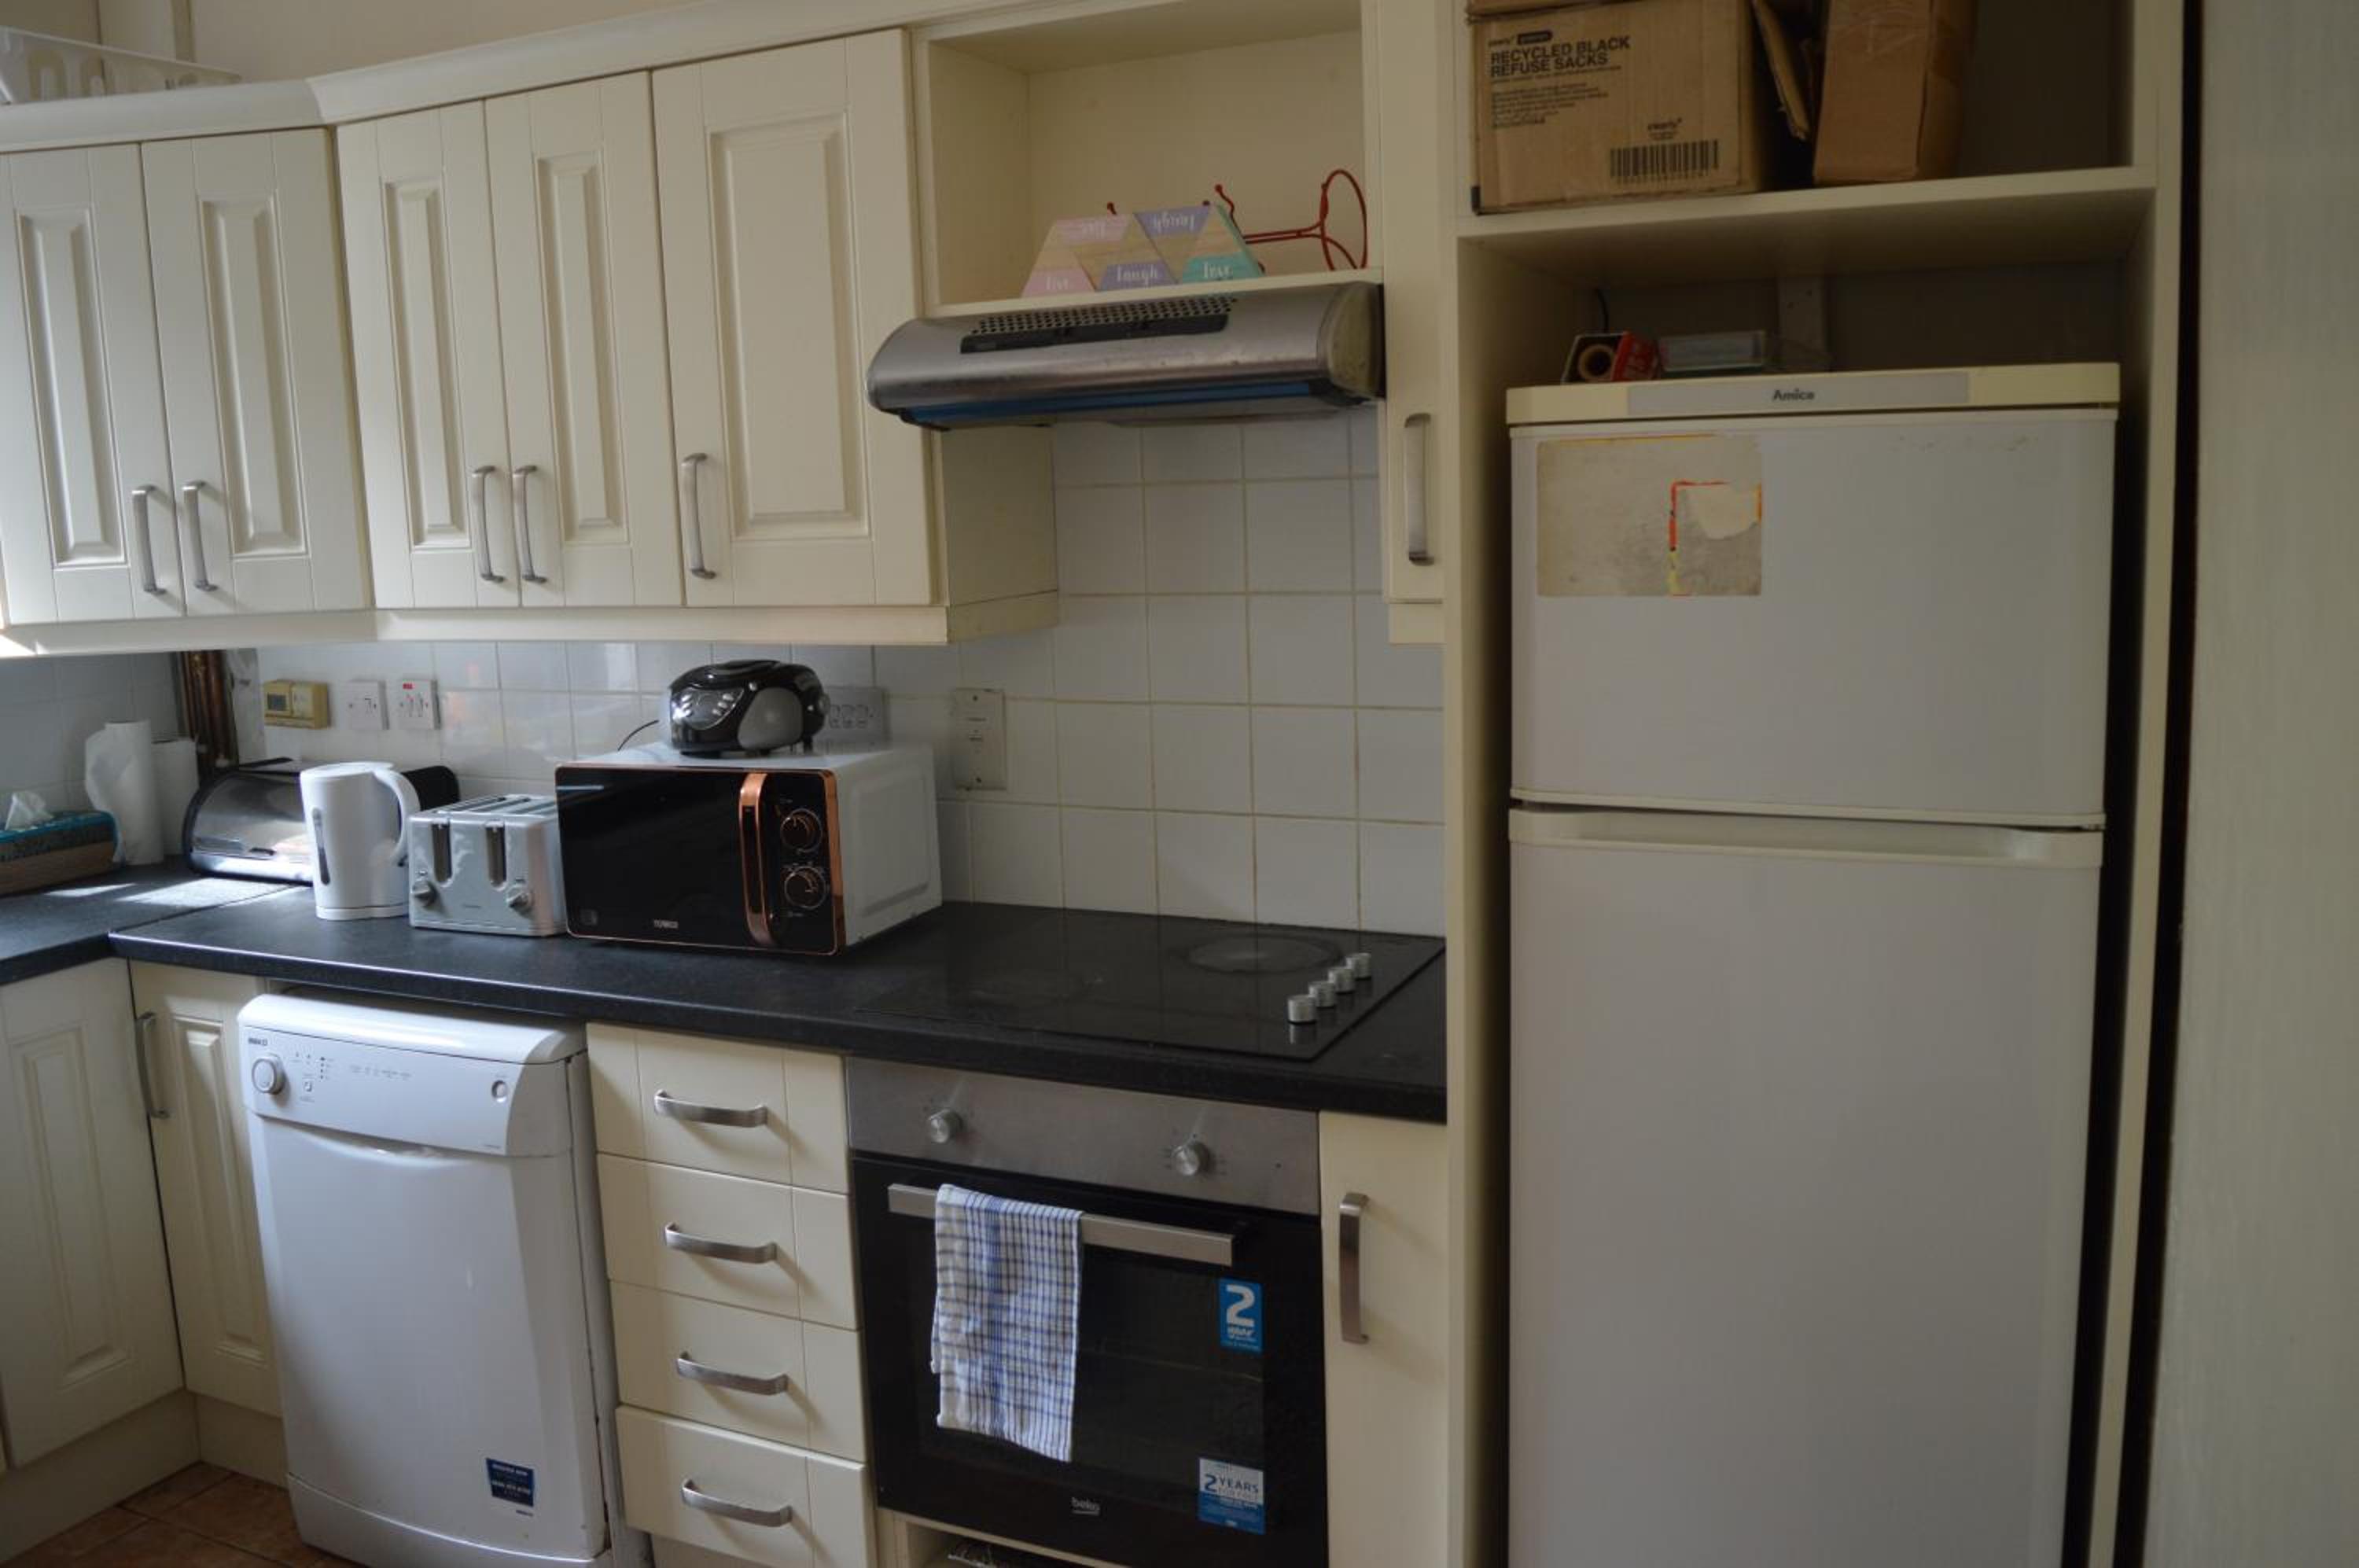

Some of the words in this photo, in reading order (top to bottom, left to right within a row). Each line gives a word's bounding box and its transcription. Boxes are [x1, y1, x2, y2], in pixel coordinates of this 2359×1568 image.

[1491, 42, 1572, 64] RECYCLED
[1577, 36, 1630, 54] BLACK
[1491, 58, 1551, 77] REFUSE
[1555, 52, 1609, 70] SACKS
[1226, 1283, 1255, 1327] 2
[1205, 1473, 1217, 1493] 2
